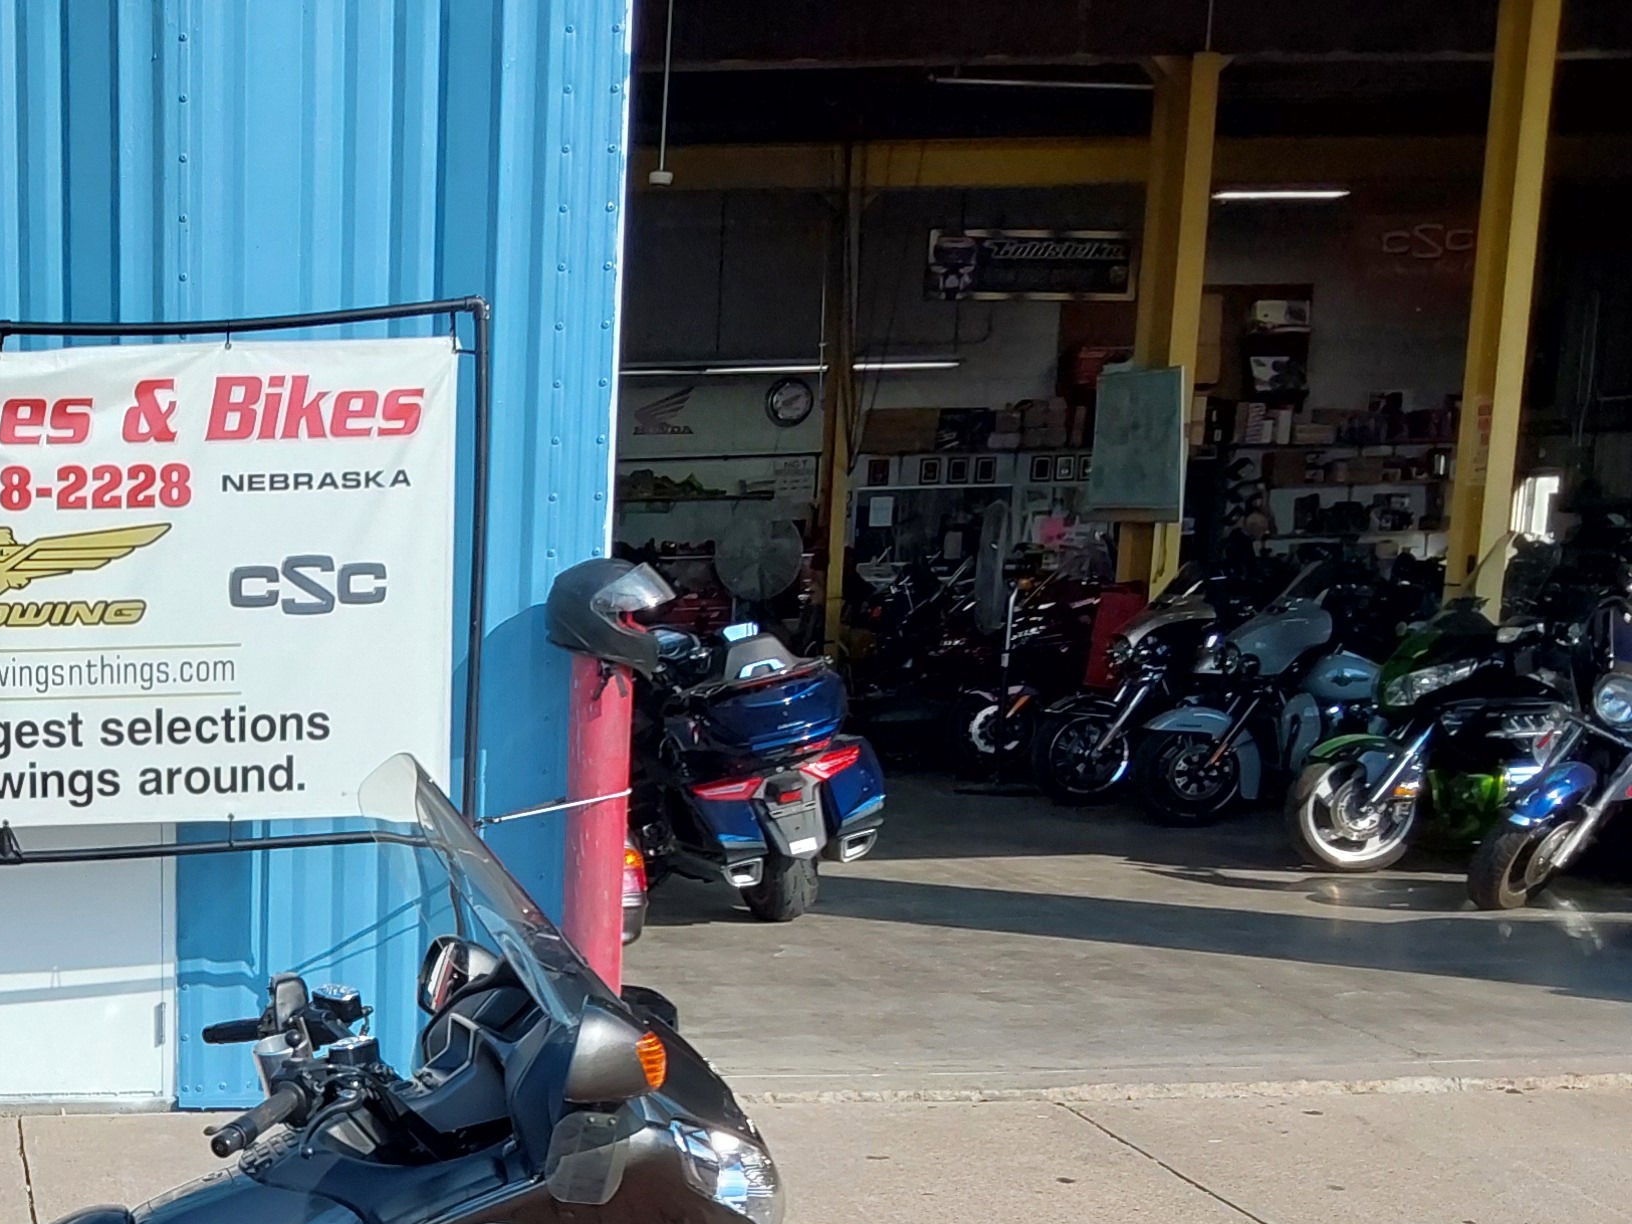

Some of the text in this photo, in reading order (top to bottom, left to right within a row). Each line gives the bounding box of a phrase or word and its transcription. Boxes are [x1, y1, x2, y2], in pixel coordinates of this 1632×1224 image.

[121, 378, 180, 444] &
[204, 374, 425, 442] Bikes
[221, 469, 412, 492] NEBRASKA
[99, 705, 331, 747] selections
[138, 754, 306, 797] around.
